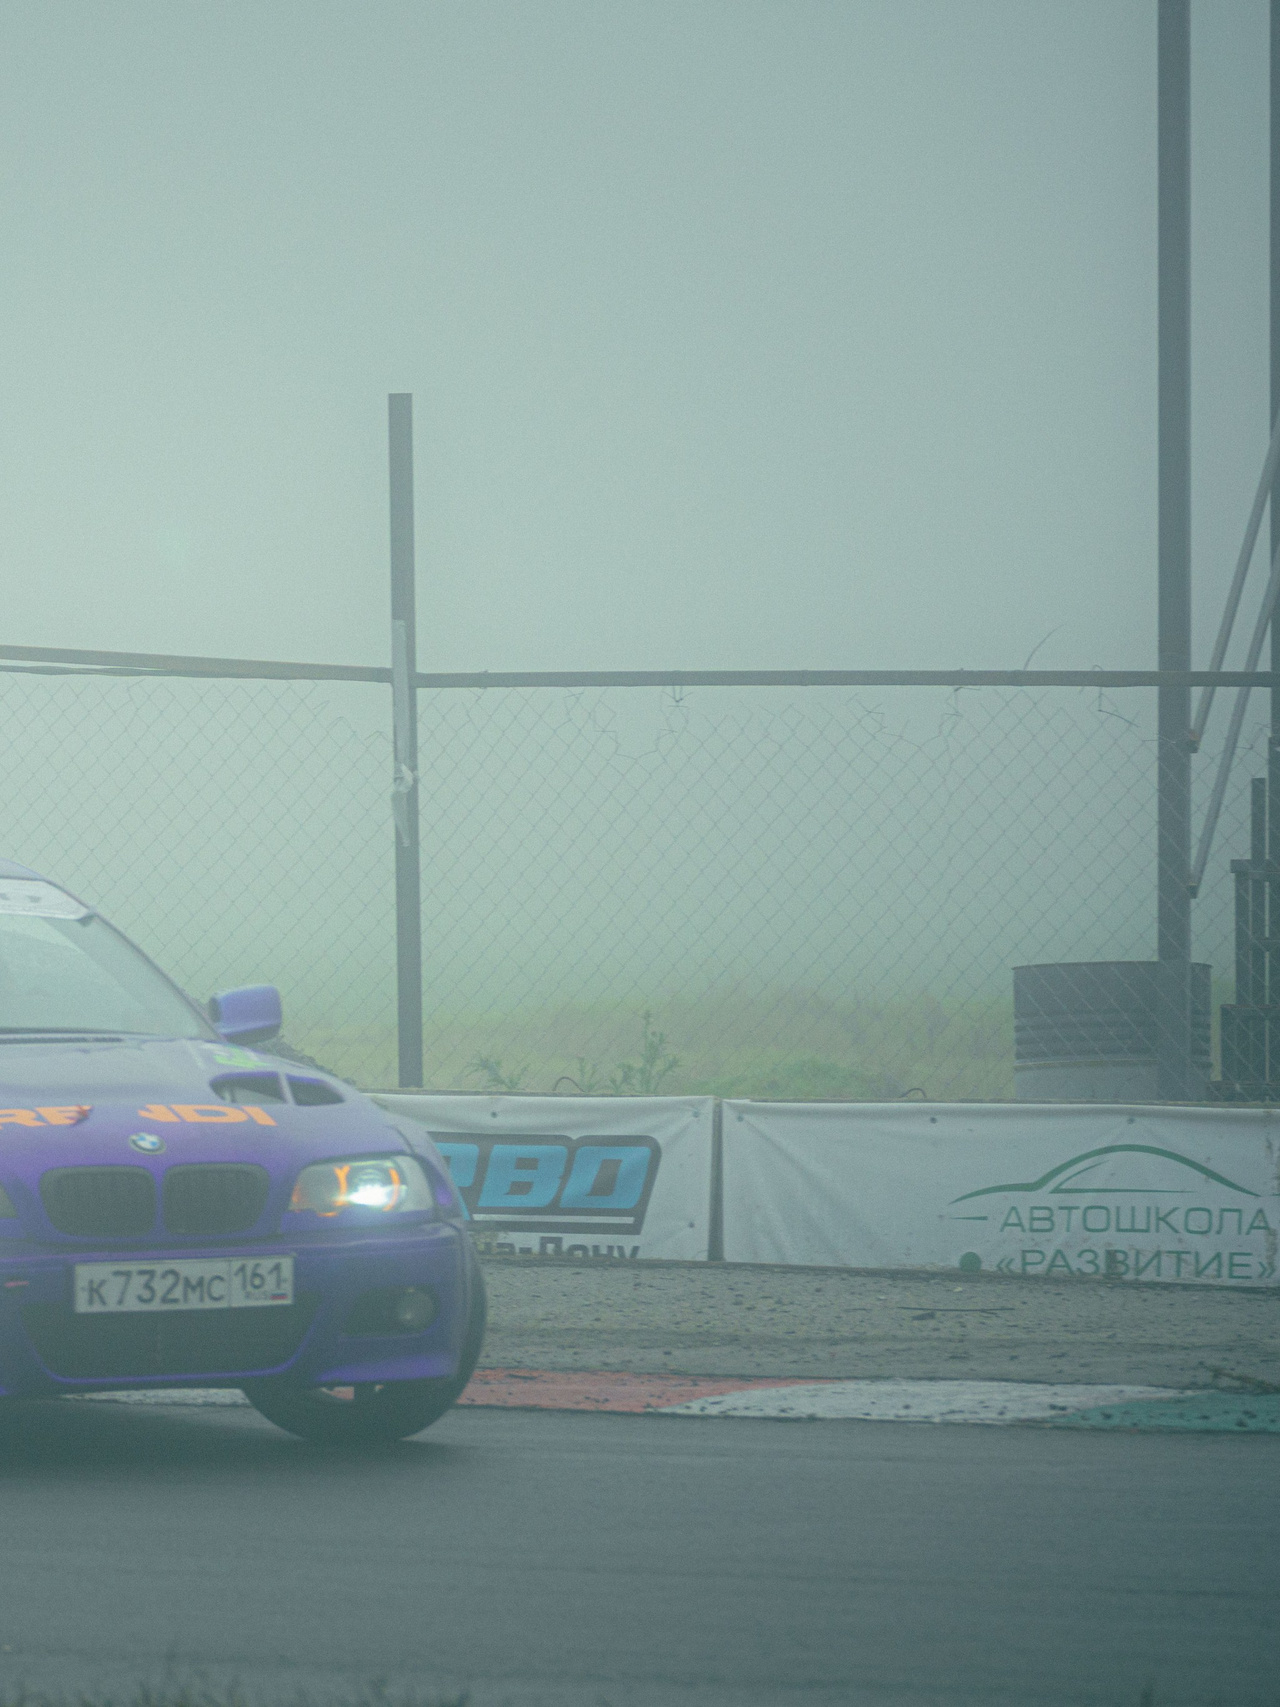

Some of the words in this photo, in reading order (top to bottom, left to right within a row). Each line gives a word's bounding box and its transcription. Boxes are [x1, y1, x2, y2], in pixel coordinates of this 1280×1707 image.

[999, 1205, 1272, 1237] АВТОШКОЛА
[233, 1261, 283, 1291] 161
[995, 1249, 1276, 1280] «РАЗВИТИЕ»
